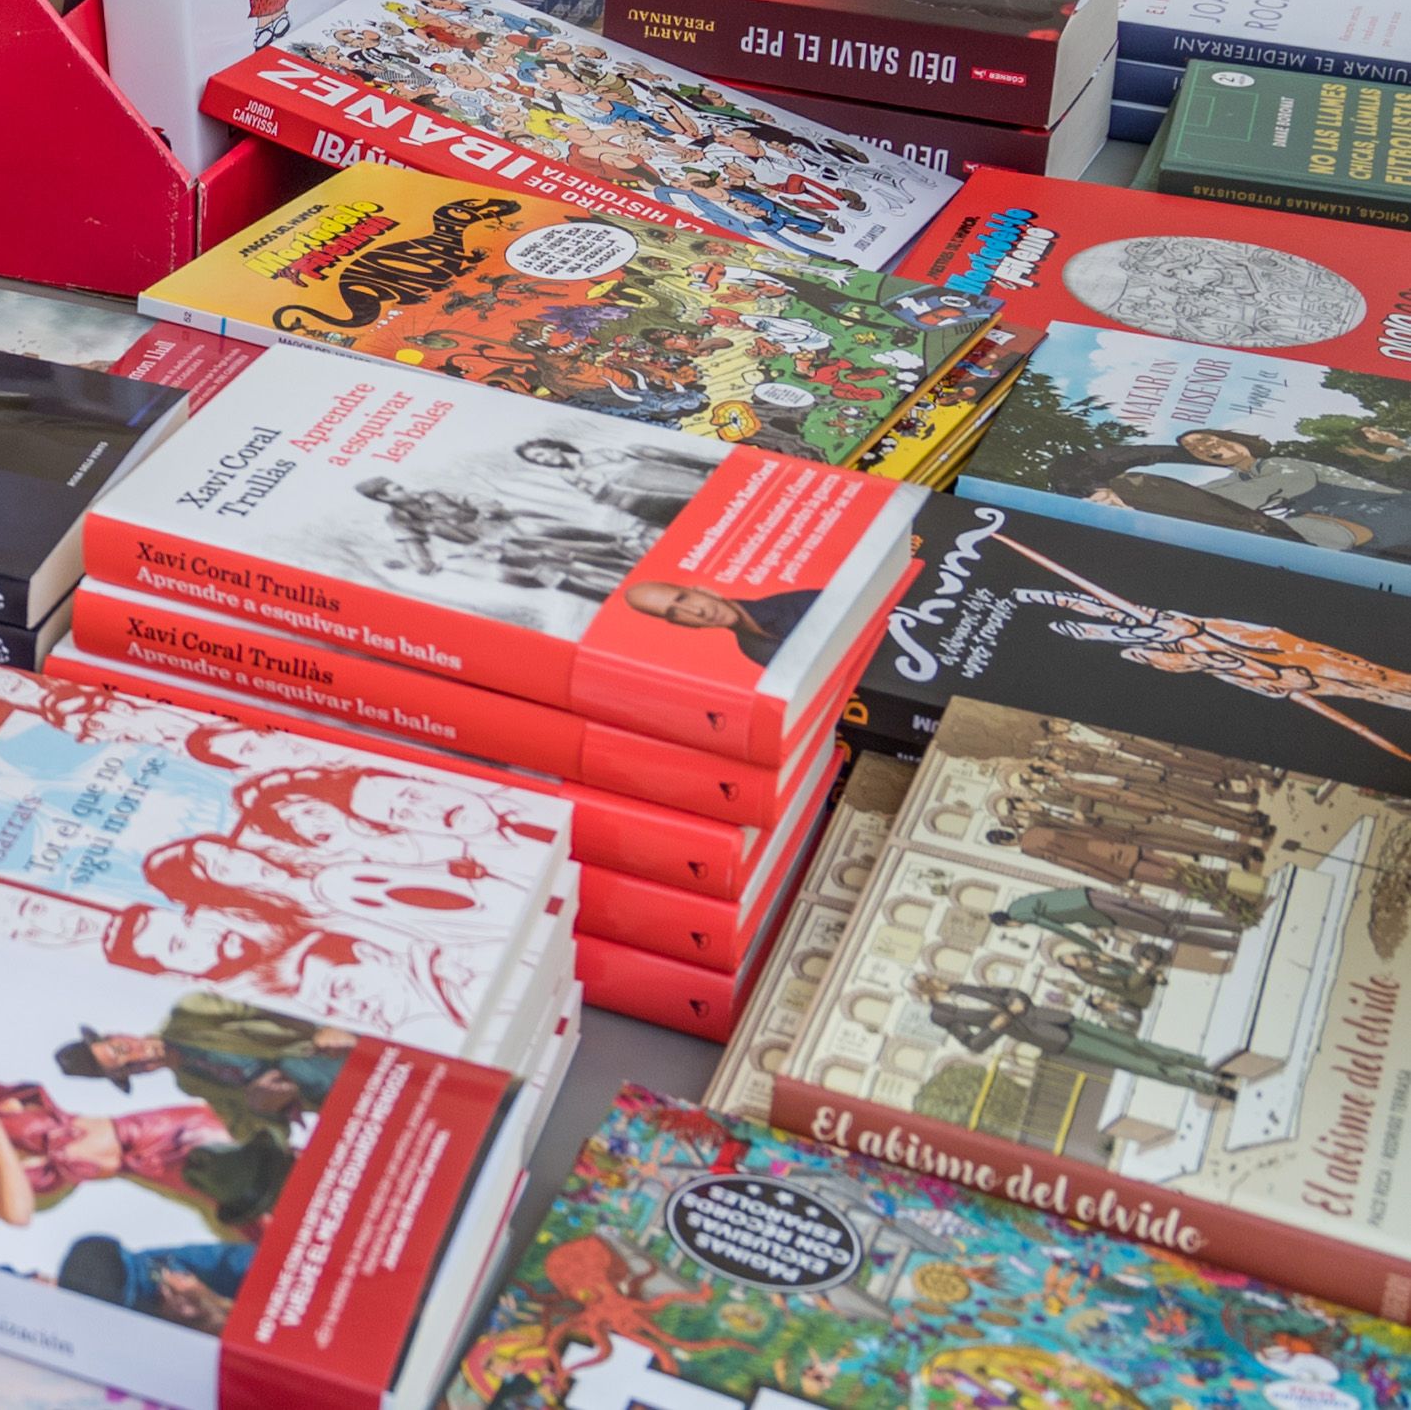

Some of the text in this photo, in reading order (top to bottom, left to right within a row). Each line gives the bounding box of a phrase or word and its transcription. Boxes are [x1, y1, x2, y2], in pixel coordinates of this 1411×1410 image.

[627, 10, 715, 32] PERARNAU
[644, 23, 697, 43] MARTÍ
[1174, 36, 1307, 67] MEDITERRANI
[739, 26, 957, 83] DÉU SALVI EL PEP
[232, 108, 279, 137] CANYISSÀ
[244, 98, 275, 119] JORDI
[256, 57, 539, 187] IBÁÑEZ
[1316, 82, 1348, 121] LLAMES
[540, 164, 666, 215] HISTORIETA
[288, 380, 376, 457] Aprendre
[1170, 357, 1233, 425] RUISEÑOR
[342, 389, 415, 458] esquivar
[374, 400, 456, 466] les bales
[178, 423, 282, 510] Xavi Coral
[218, 456, 299, 519] Trullàs
[135, 542, 341, 614] Xavi Coral Trullàs
[135, 565, 236, 614] Aprendre
[1324, 1088, 1378, 1186] abismo
[859, 1128, 1206, 1254] abismo del olvido
